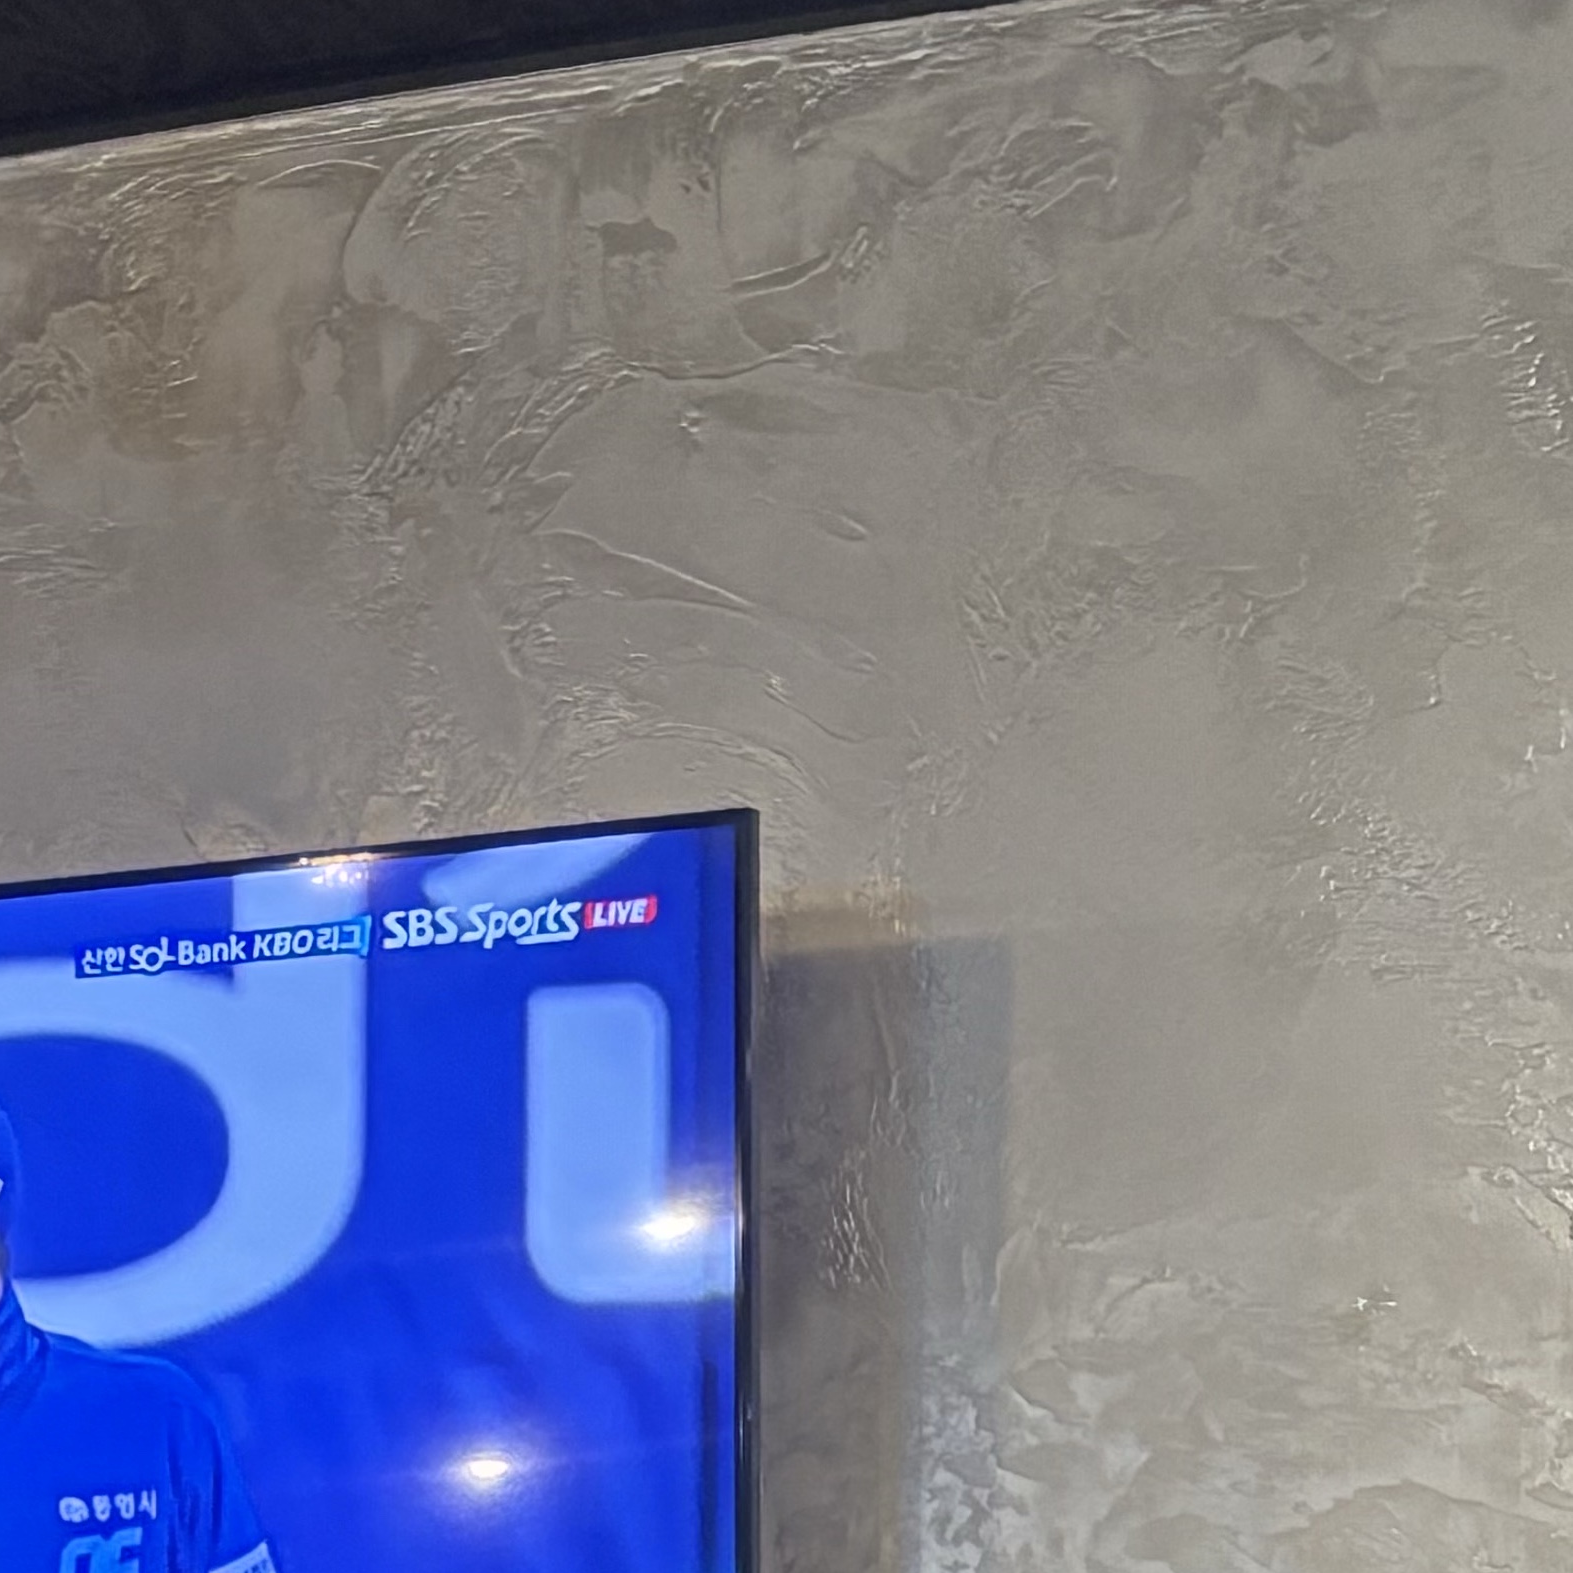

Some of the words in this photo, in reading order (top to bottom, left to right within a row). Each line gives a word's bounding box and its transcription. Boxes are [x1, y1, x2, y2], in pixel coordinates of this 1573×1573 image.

[177, 934, 247, 966] Bank
[253, 930, 314, 958] KBO
[316, 925, 363, 952] 리그
[383, 906, 459, 949] SBS
[459, 898, 581, 949] Sports
[591, 897, 649, 928] LIVE
